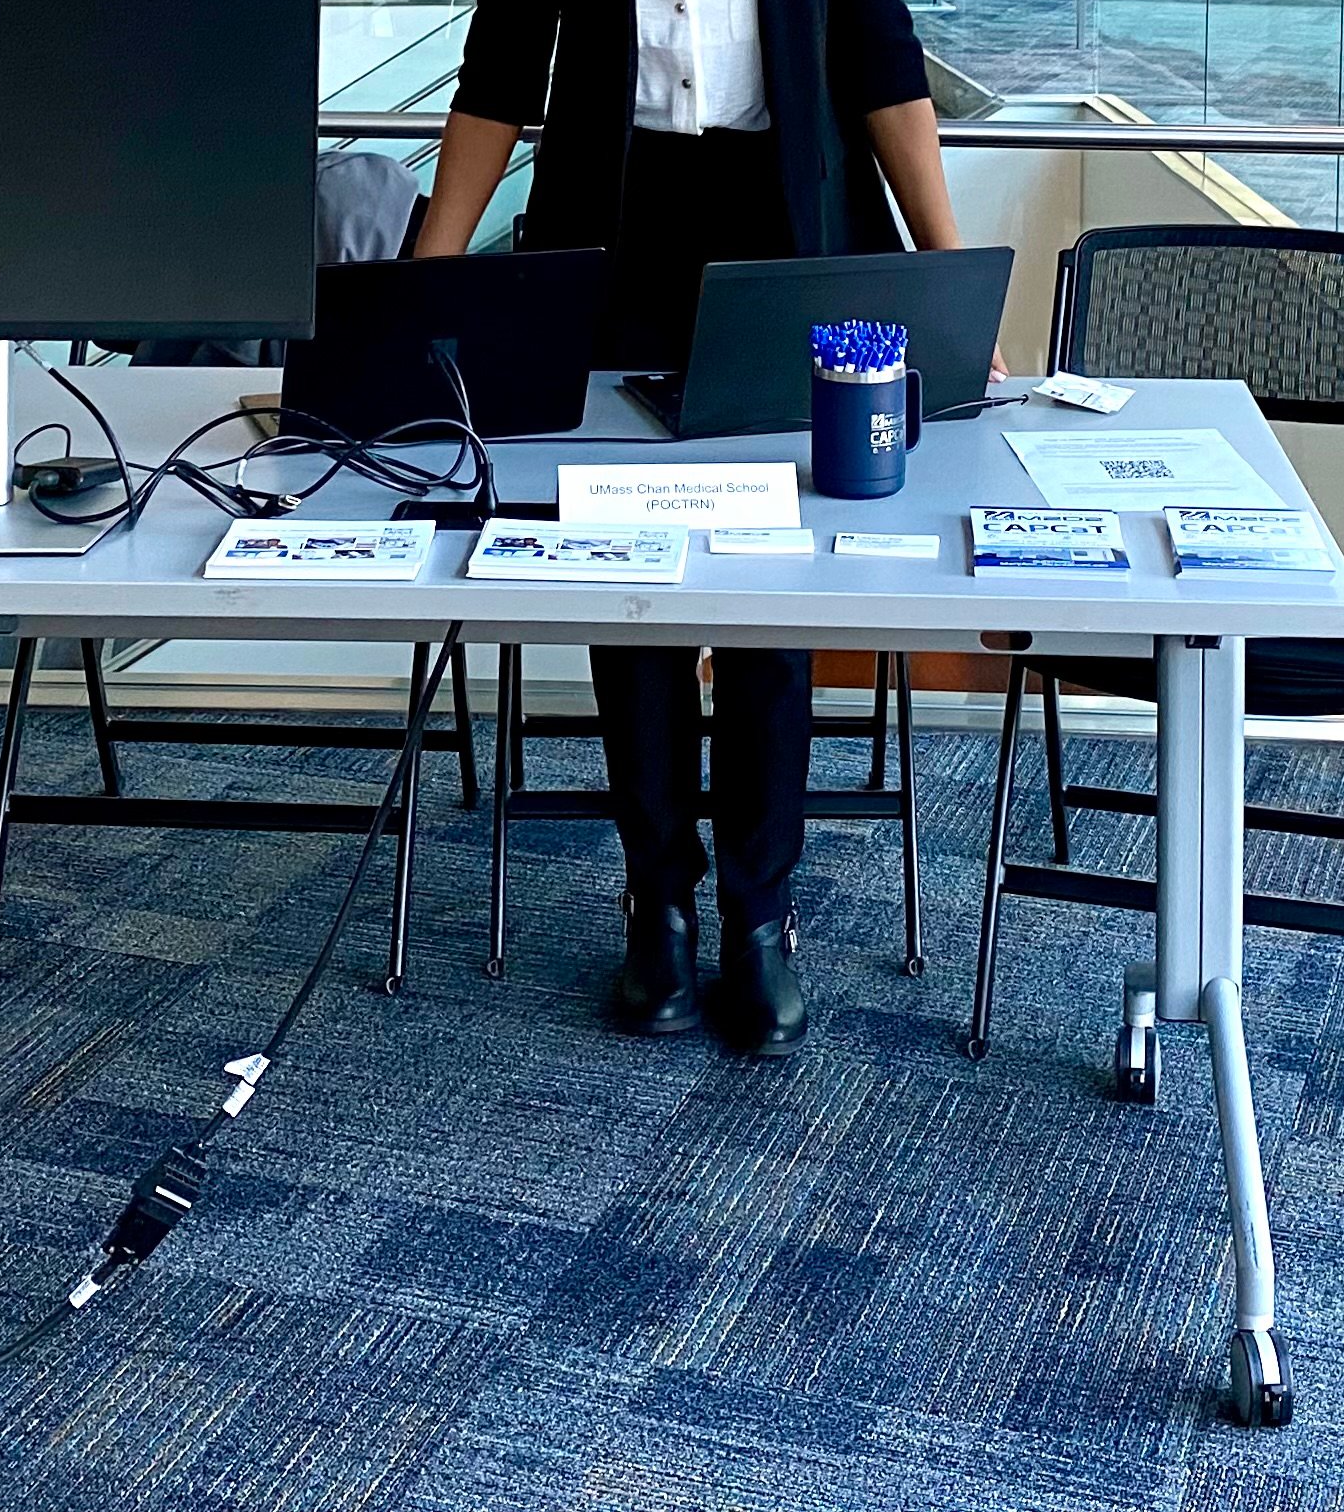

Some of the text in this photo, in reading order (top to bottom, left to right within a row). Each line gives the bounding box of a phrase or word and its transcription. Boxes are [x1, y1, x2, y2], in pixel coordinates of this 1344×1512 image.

[589, 482, 768, 494] UMass Chan Medical School
[646, 498, 714, 512] (POCTRN)
[983, 523, 1107, 534] CAPCaT
